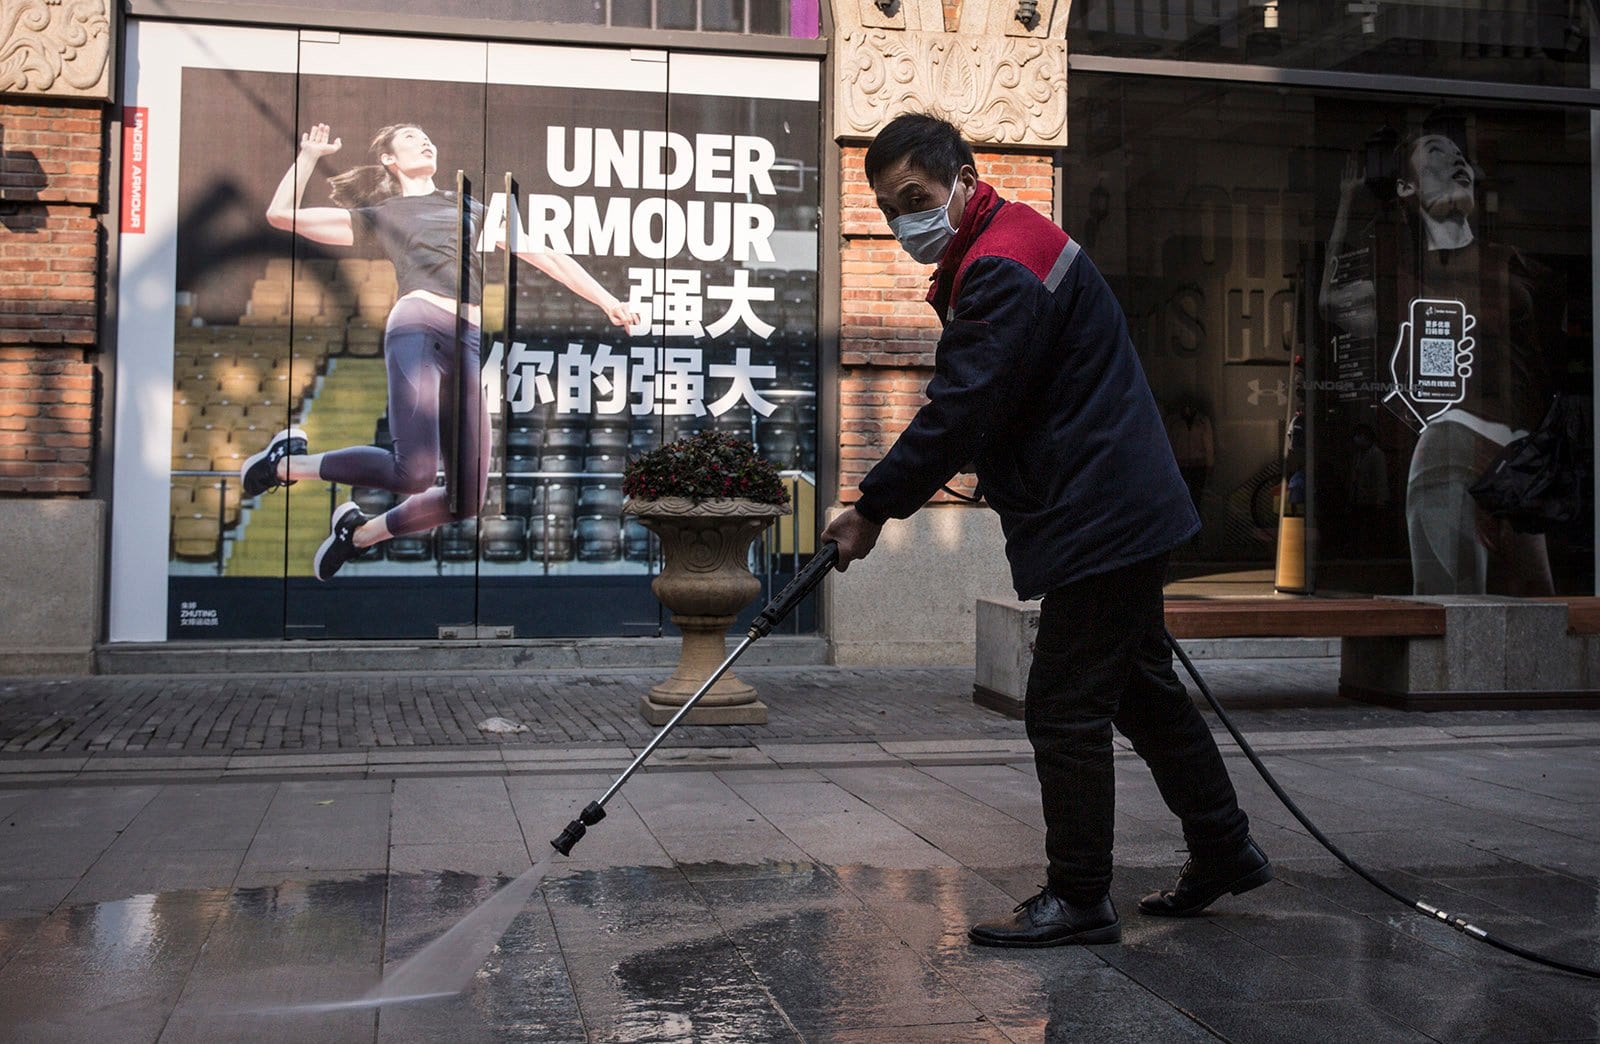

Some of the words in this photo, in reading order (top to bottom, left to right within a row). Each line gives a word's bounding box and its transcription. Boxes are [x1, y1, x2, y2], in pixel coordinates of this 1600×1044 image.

[133, 113, 144, 162] UNDER
[546, 125, 778, 196] UNDER
[131, 165, 142, 229] ARMOUR
[475, 191, 777, 263] ARMOUR
[628, 267, 777, 340] 强大
[481, 340, 779, 418] 你的强大
[180, 610, 217, 618] ZHUTING
